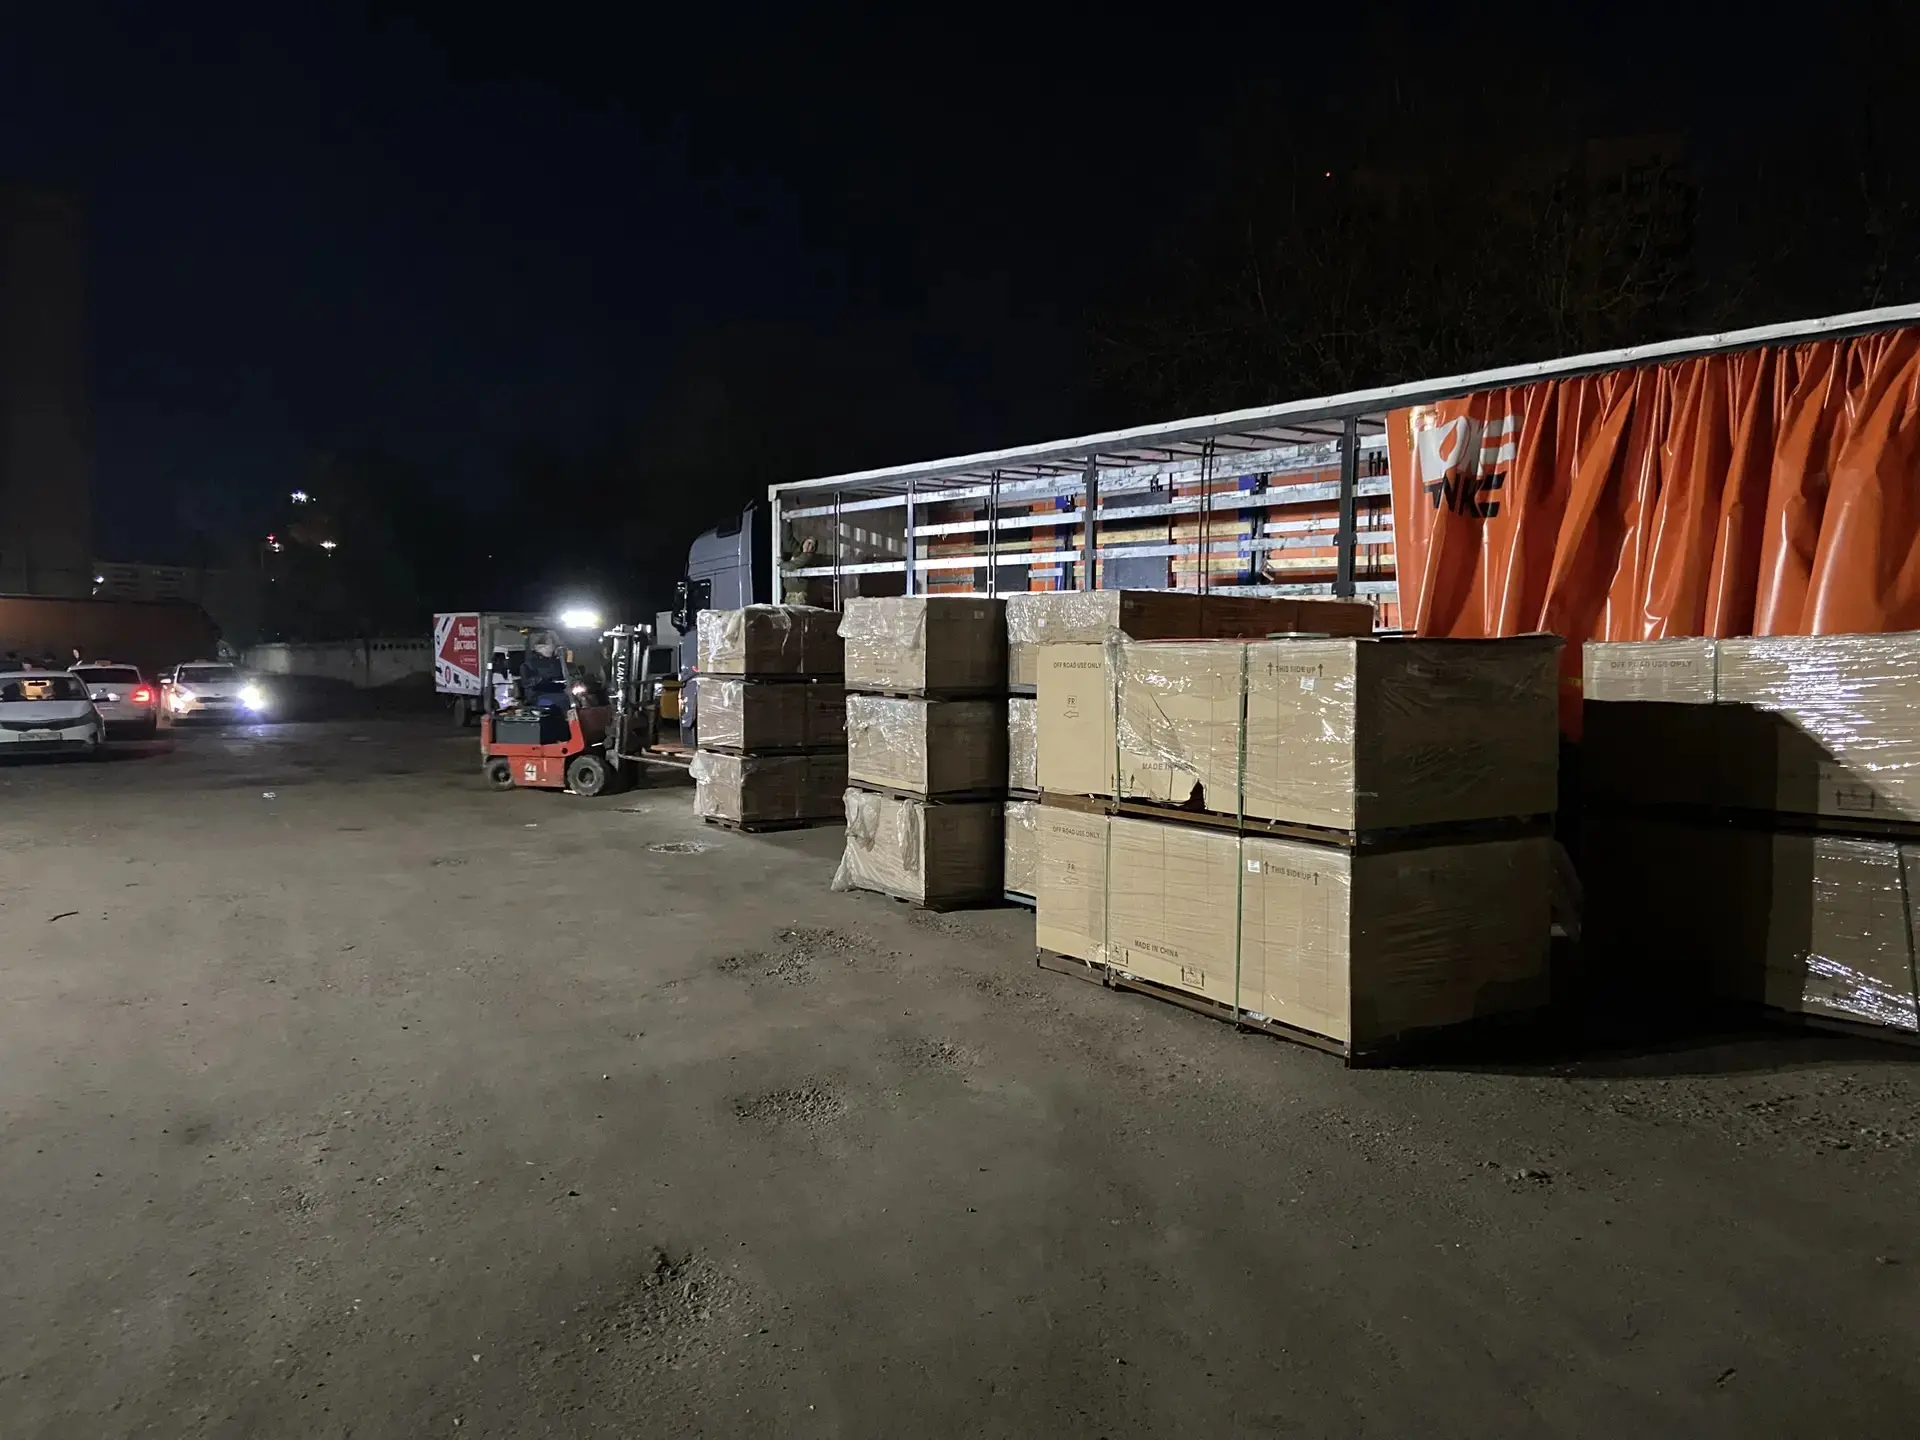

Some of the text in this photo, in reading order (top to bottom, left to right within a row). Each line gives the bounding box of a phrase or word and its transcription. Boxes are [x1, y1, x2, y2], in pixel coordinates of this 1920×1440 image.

[1276, 665, 1316, 674] THIS SIDE UP
[1142, 762, 1164, 770] MADE
[1062, 827, 1076, 836] ROAD
[1085, 831, 1100, 839] ONLY
[1271, 865, 1312, 881] THIS SIDE UP
[1134, 939, 1179, 958] MADE IN CHINA
